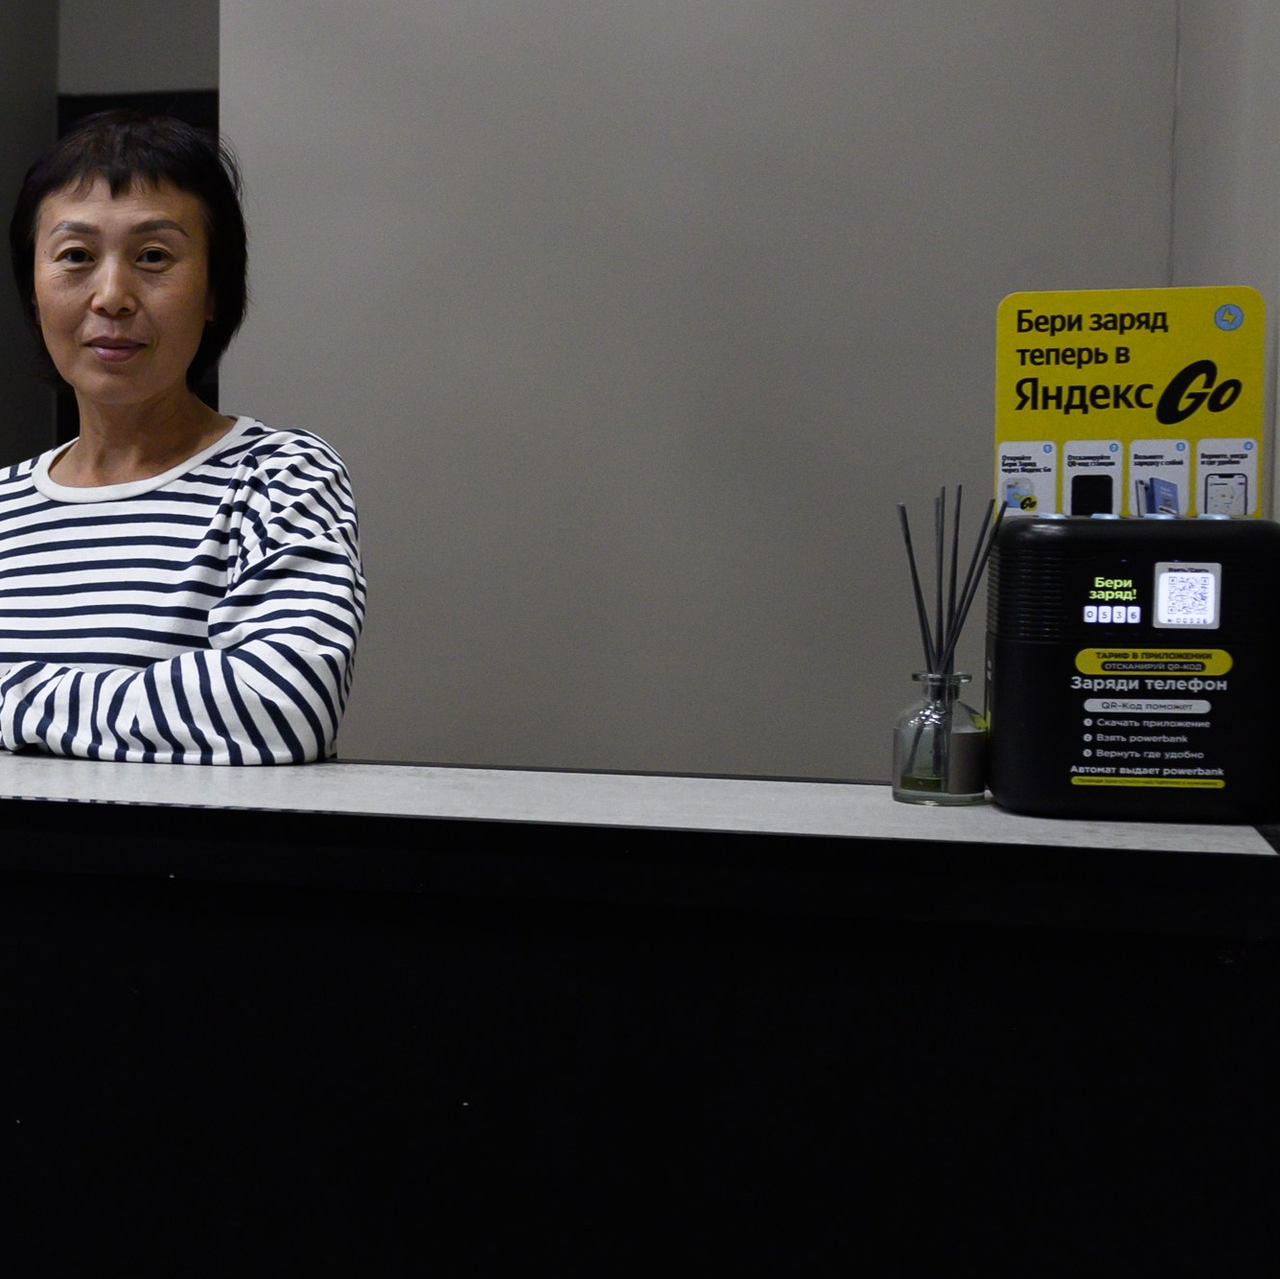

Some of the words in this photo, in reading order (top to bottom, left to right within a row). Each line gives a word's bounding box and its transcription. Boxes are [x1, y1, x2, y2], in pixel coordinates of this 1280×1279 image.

[1016, 309, 1083, 337] Бери
[1089, 311, 1169, 335] заряд
[1016, 346, 1109, 369] теперь
[1115, 346, 1130, 364] в
[1015, 377, 1154, 414] Яндекс
[1156, 359, 1243, 425] Go
[1020, 496, 1037, 510] Go
[1094, 577, 1132, 590] Бери
[1089, 589, 1137, 601] заряд!
[1086, 610, 1137, 620] 0536
[1095, 652, 1130, 660] ТАРИФ
[1141, 652, 1212, 660] ПРИЛОЖЕНИИ
[1104, 661, 1166, 670] ОТСКАНИРУЙ
[1167, 663, 1203, 671] QR-КОД
[1070, 676, 1139, 691] Заряди
[1145, 678, 1228, 693] телефон
[1101, 701, 1143, 710] QR-Код
[1096, 718, 1140, 727] Скачать
[1142, 720, 1211, 728] приложение
[1096, 734, 1127, 742] Взять
[1129, 734, 1189, 743] powerbank
[1096, 749, 1141, 759] Вернуть
[1143, 751, 1161, 759] где
[1164, 750, 1204, 759] удобно
[1070, 765, 1116, 774] Автомат
[1119, 767, 1160, 775] выдает
[1162, 767, 1225, 776] powerbank
